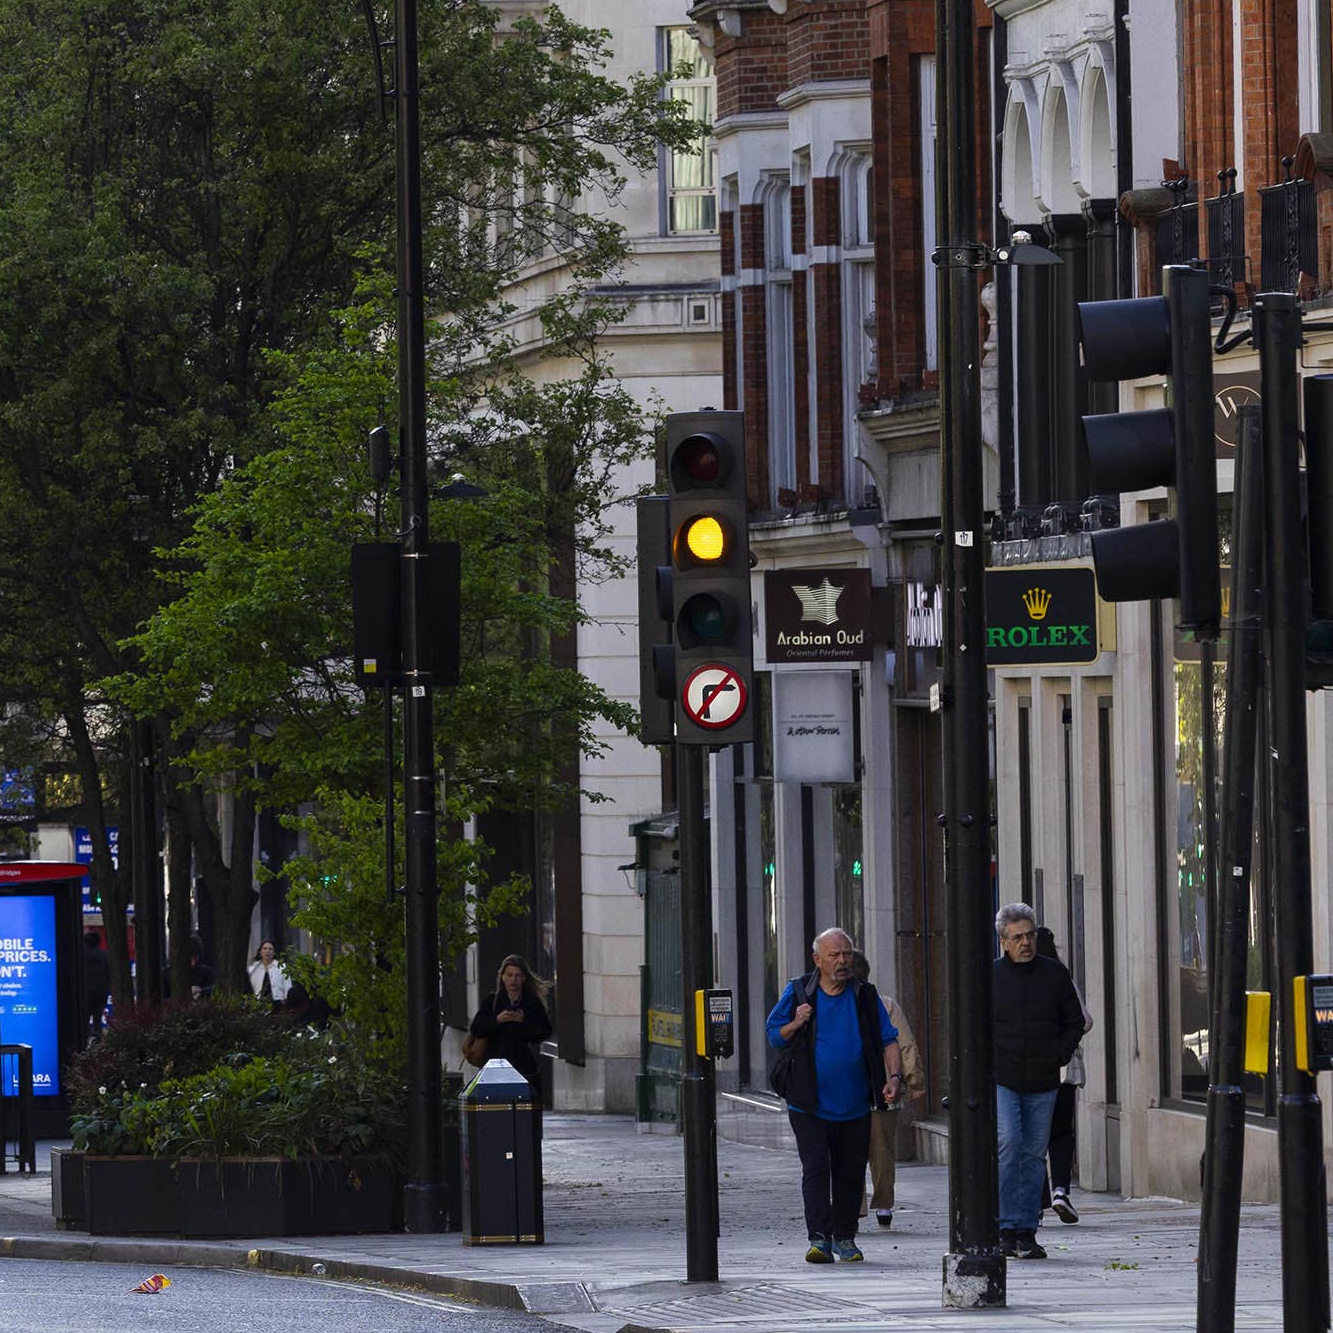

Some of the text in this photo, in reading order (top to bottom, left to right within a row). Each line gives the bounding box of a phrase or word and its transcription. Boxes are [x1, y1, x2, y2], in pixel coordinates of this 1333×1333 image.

[777, 629, 864, 646] Arabian Oud
[986, 626, 1091, 648] ROLEX
[786, 648, 854, 657] Oriental Perfumes
[711, 1013, 732, 1023] WAIT
[13, 1073, 51, 1083] LARA
